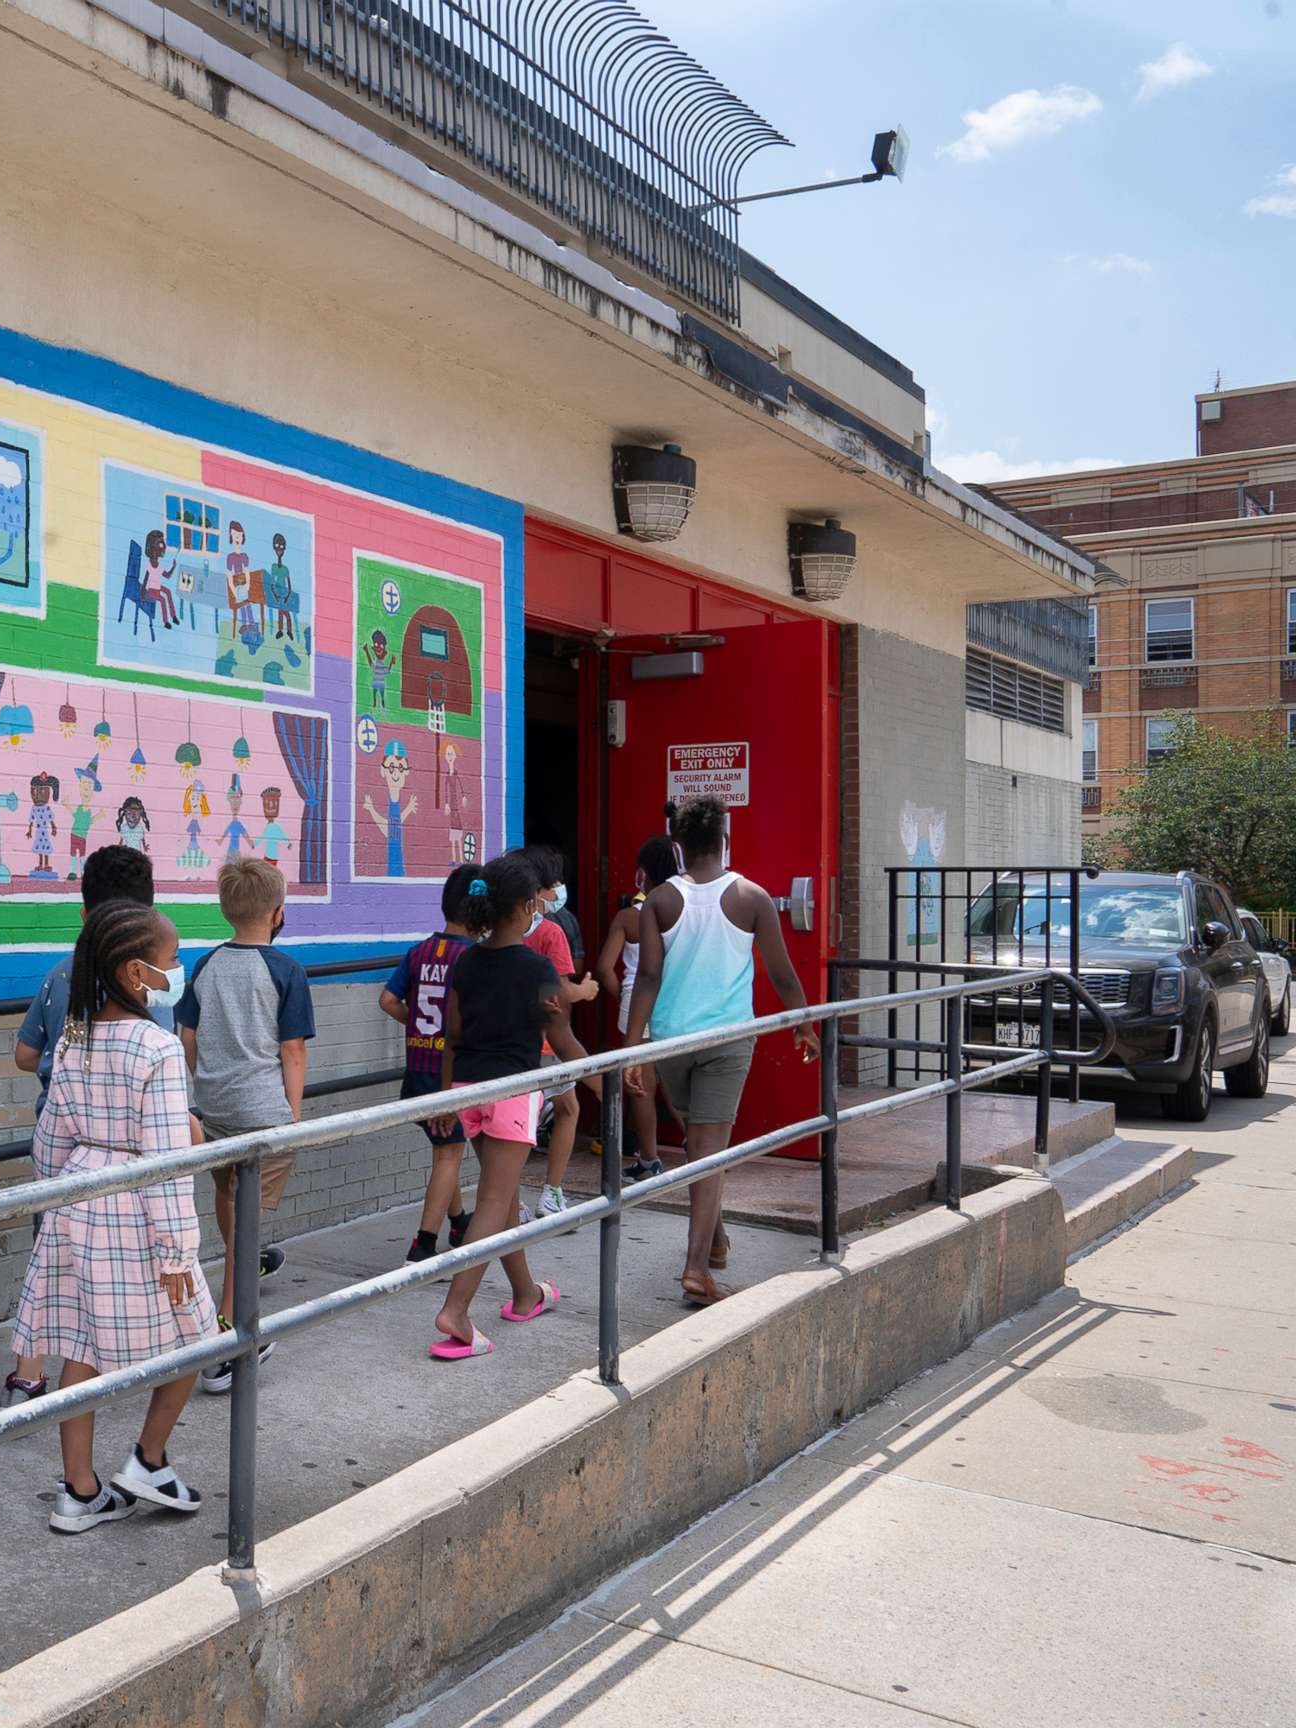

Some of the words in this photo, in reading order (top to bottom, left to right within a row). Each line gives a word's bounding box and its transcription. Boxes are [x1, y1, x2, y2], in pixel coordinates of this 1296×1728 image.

[674, 747, 740, 759] EMERGENCY
[680, 760, 704, 769] EXIT
[707, 758, 735, 768] ONLY
[674, 774, 711, 783] SECURITY
[713, 773, 741, 781] ALARM
[683, 784, 702, 793] WILL
[704, 783, 732, 792] SOUND
[420, 963, 448, 983] KAY
[415, 984, 446, 1035] 5
